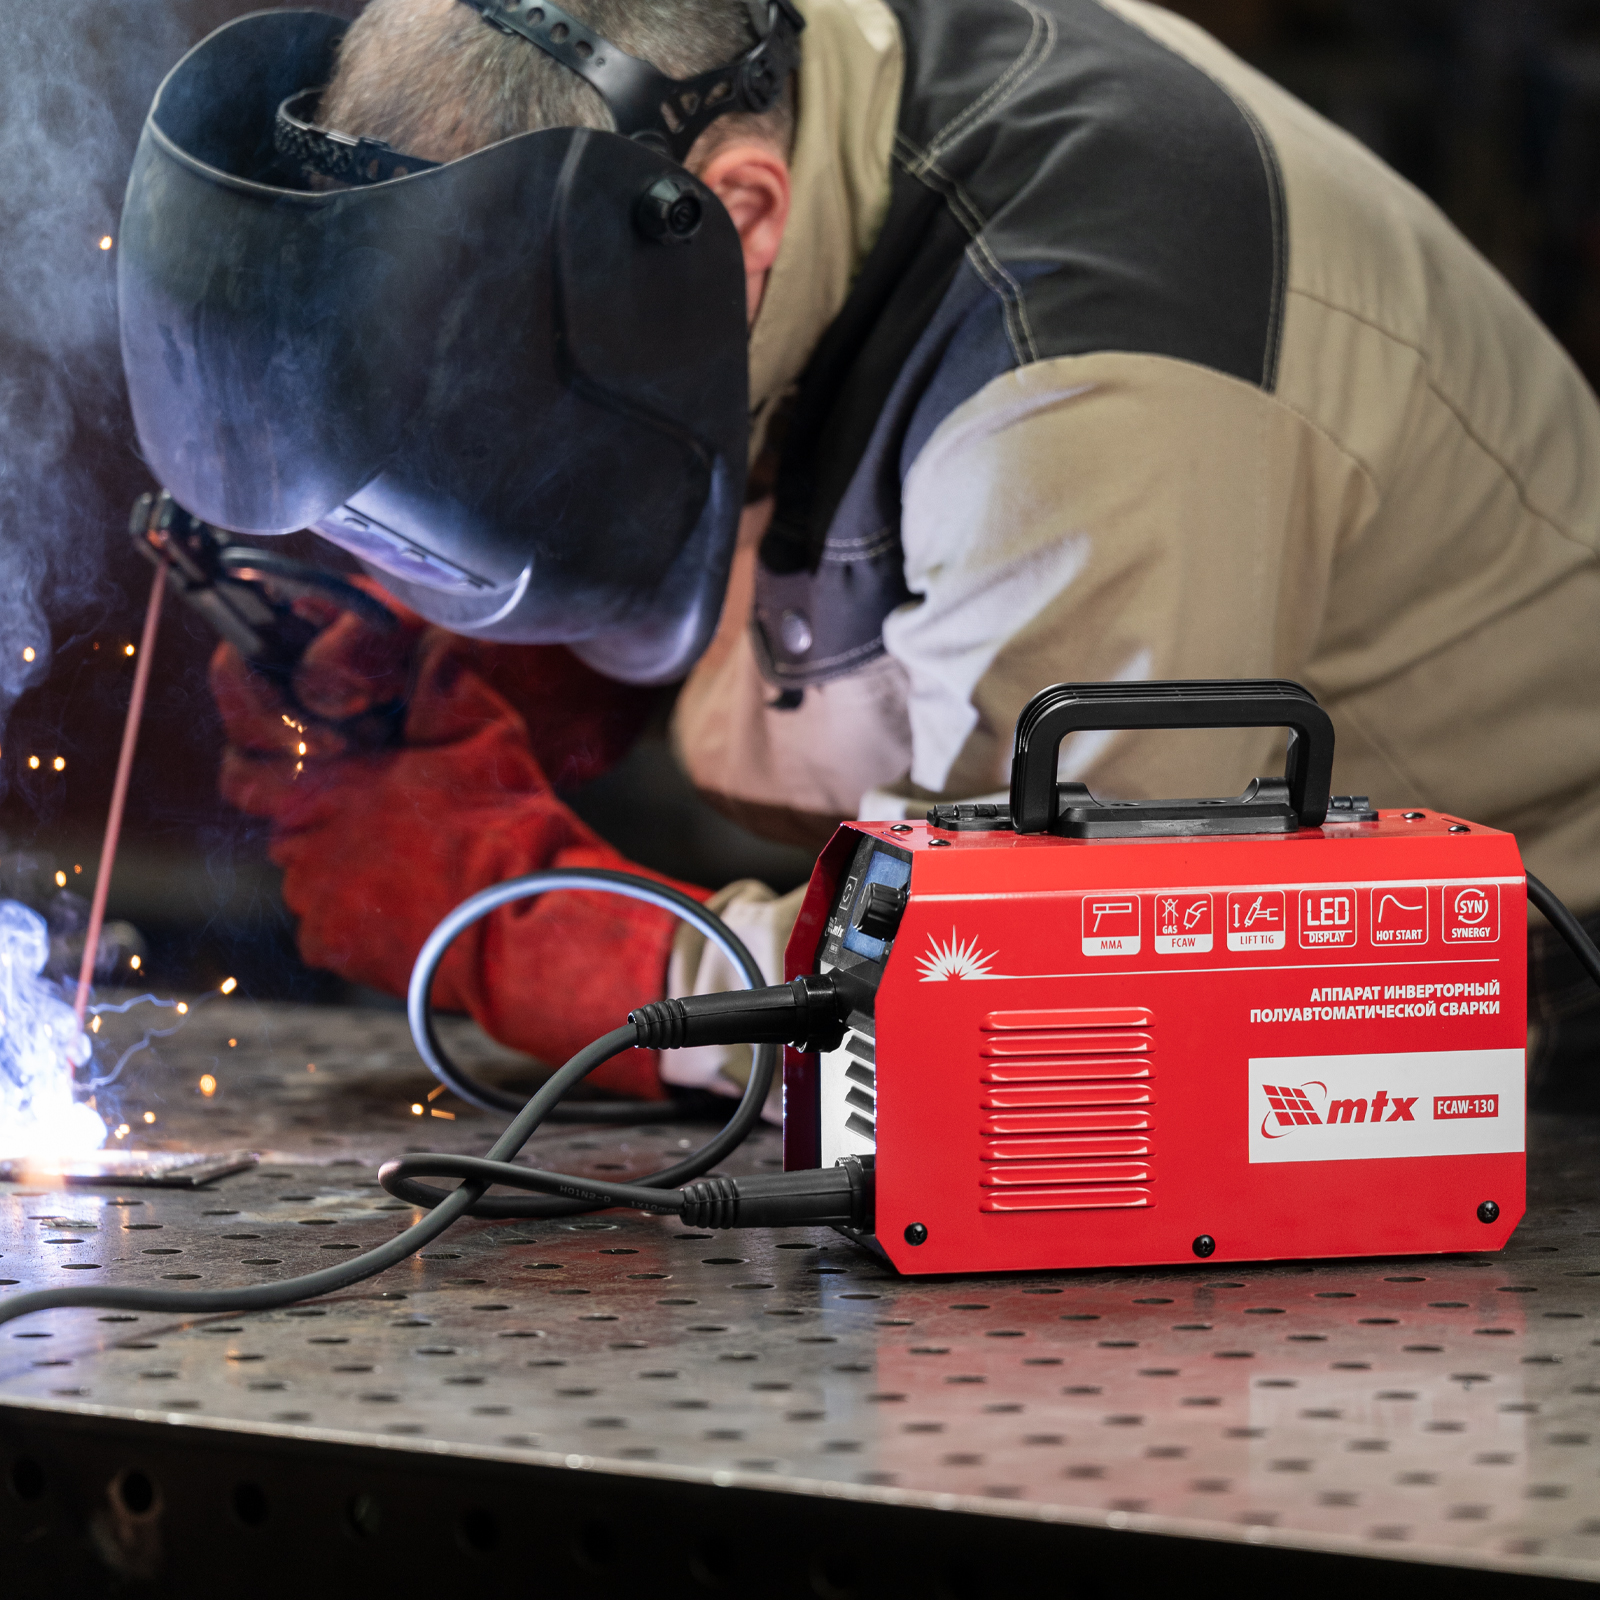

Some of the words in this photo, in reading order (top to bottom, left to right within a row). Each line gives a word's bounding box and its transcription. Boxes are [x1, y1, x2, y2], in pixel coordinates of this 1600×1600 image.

[1307, 897, 1350, 926] LED
[1459, 900, 1483, 914] SYN
[1162, 925, 1178, 934] GAS
[1376, 930, 1395, 941] HOT
[1395, 929, 1423, 940] START
[1451, 927, 1491, 938] SYNERGY
[1171, 938, 1196, 948] FCAW
[1240, 935, 1258, 945] LIFT
[1260, 935, 1274, 944] TIG
[1309, 932, 1346, 943] DISPLAY
[1100, 940, 1122, 950] MMA
[1310, 986, 1381, 1002] АППАРАТ
[1384, 979, 1500, 1000] ИНВЕРТОРНЫЙ
[1250, 1000, 1437, 1023] ПОЛУАВТОМАТИЧЕСКОЙ
[1439, 1001, 1500, 1016] СВАРКИ
[1326, 1090, 1420, 1125] mtx
[1437, 1099, 1495, 1115] FCAW-130
[559, 1185, 612, 1203] H01N2-D
